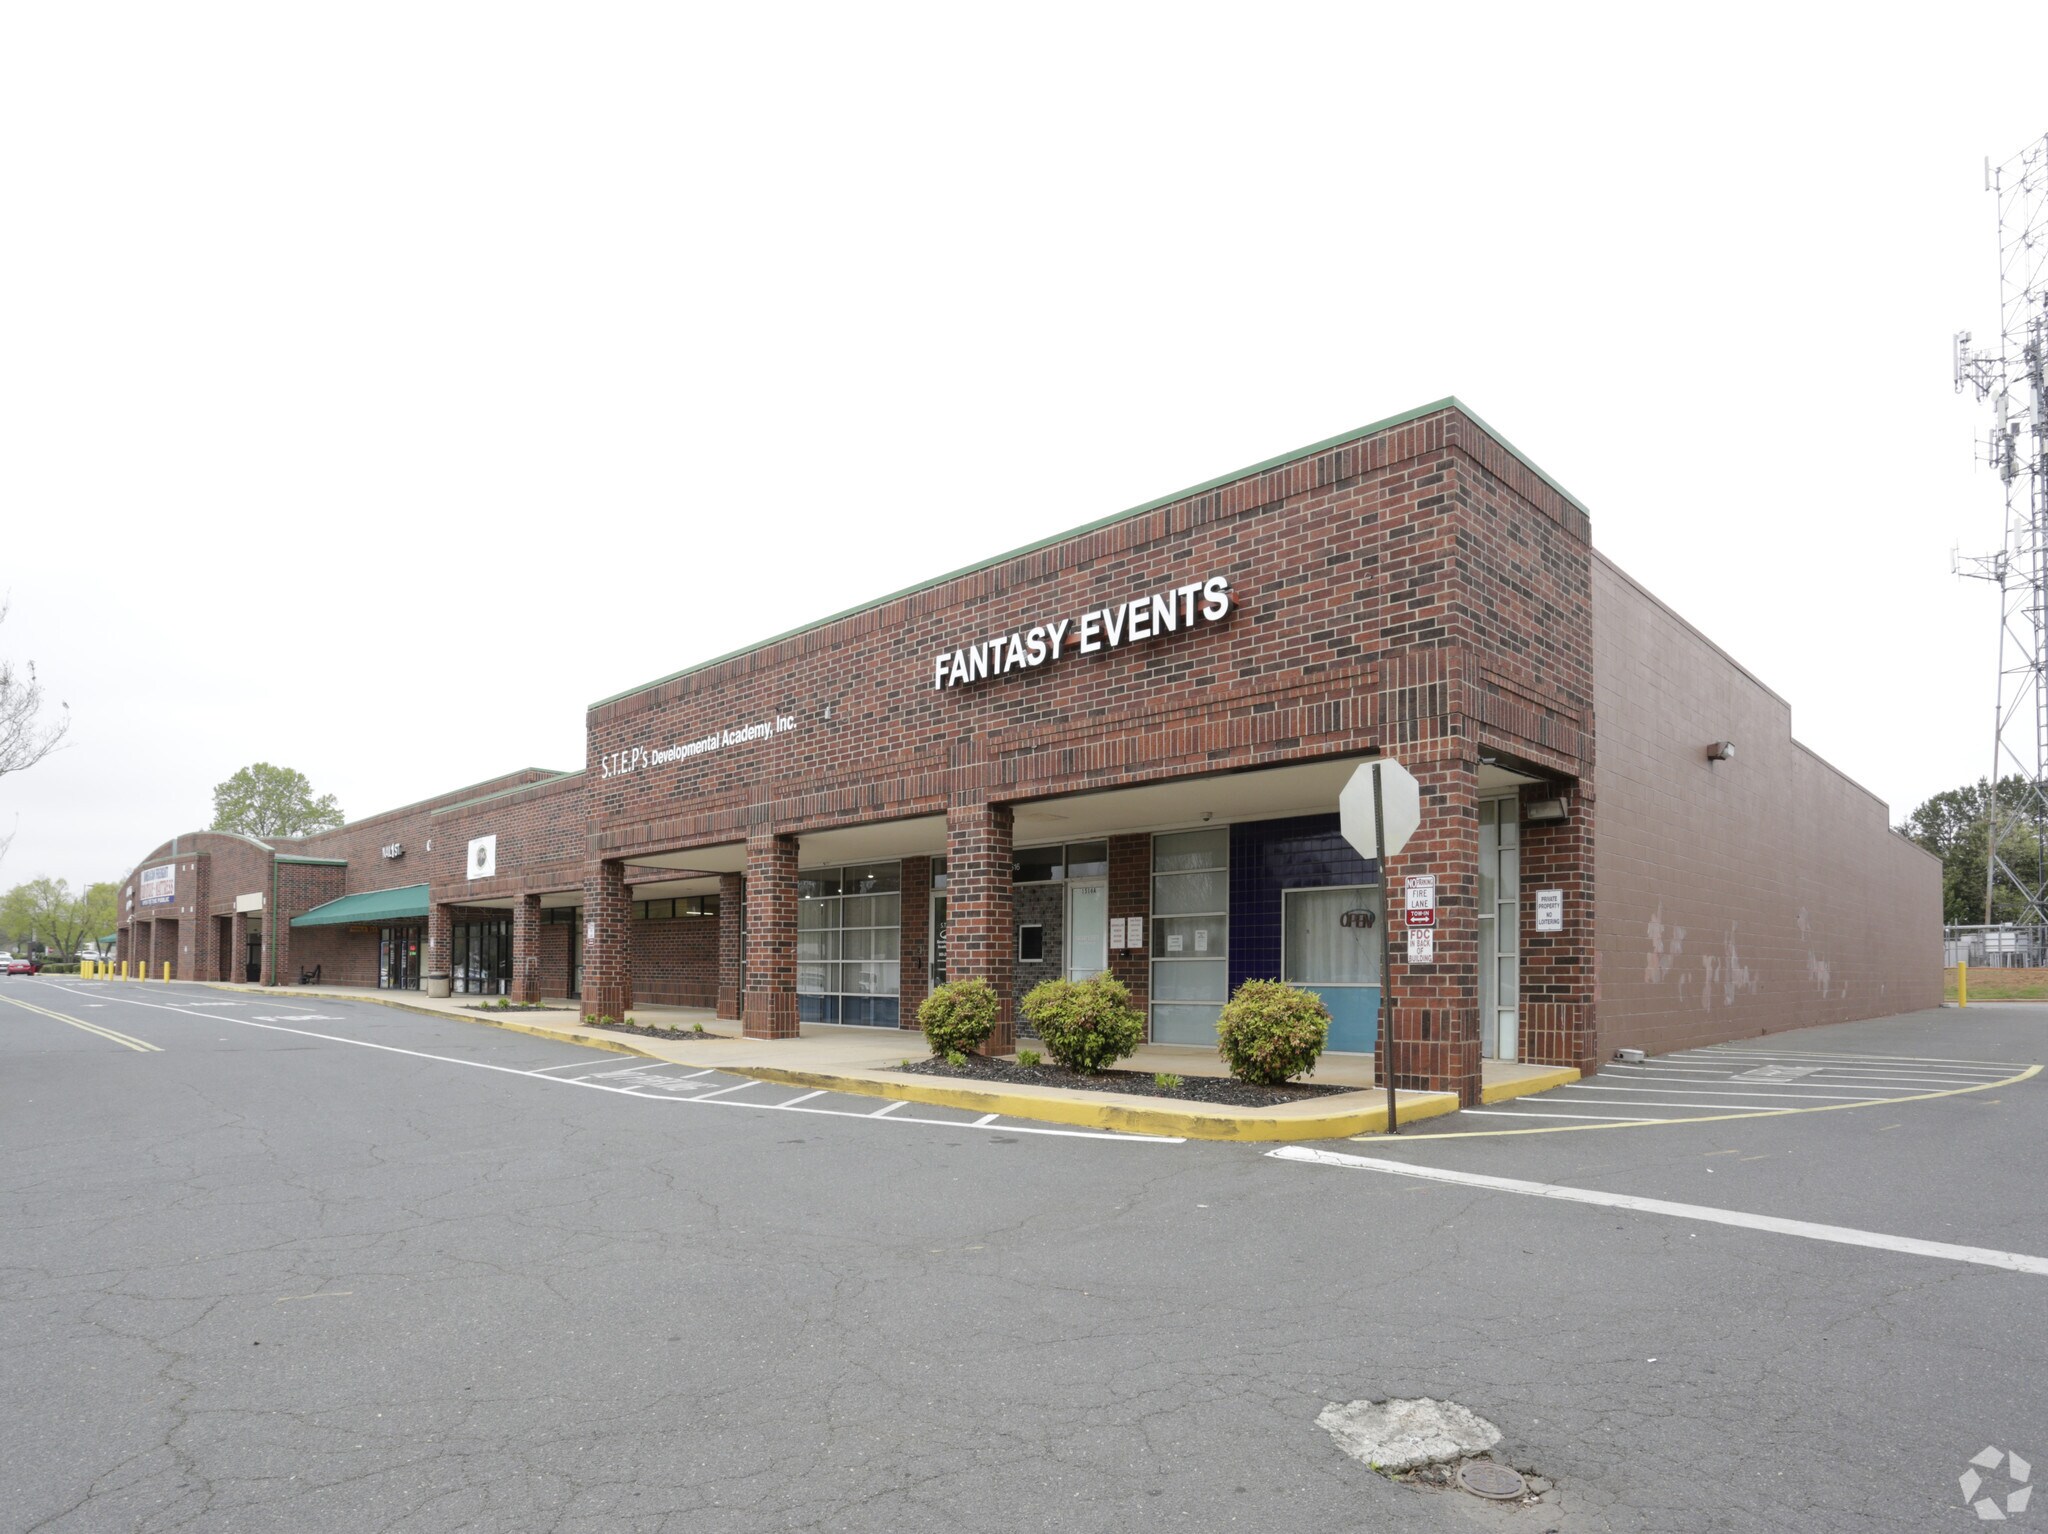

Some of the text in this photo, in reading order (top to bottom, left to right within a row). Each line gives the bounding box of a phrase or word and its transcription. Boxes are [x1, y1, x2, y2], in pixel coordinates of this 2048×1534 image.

[935, 576, 1231, 690] FANTASY EVENTS
[652, 733, 719, 766] Developmental
[721, 724, 773, 748] Academy,
[776, 714, 797, 733] Inc.
[1408, 878, 1417, 888] NO
[1412, 889, 1427, 898] FIRE
[1411, 900, 1429, 908] LANE
[1340, 912, 1374, 929] OPEN
[1410, 929, 1430, 939] FDC
[1409, 954, 1432, 962] BUILDING
